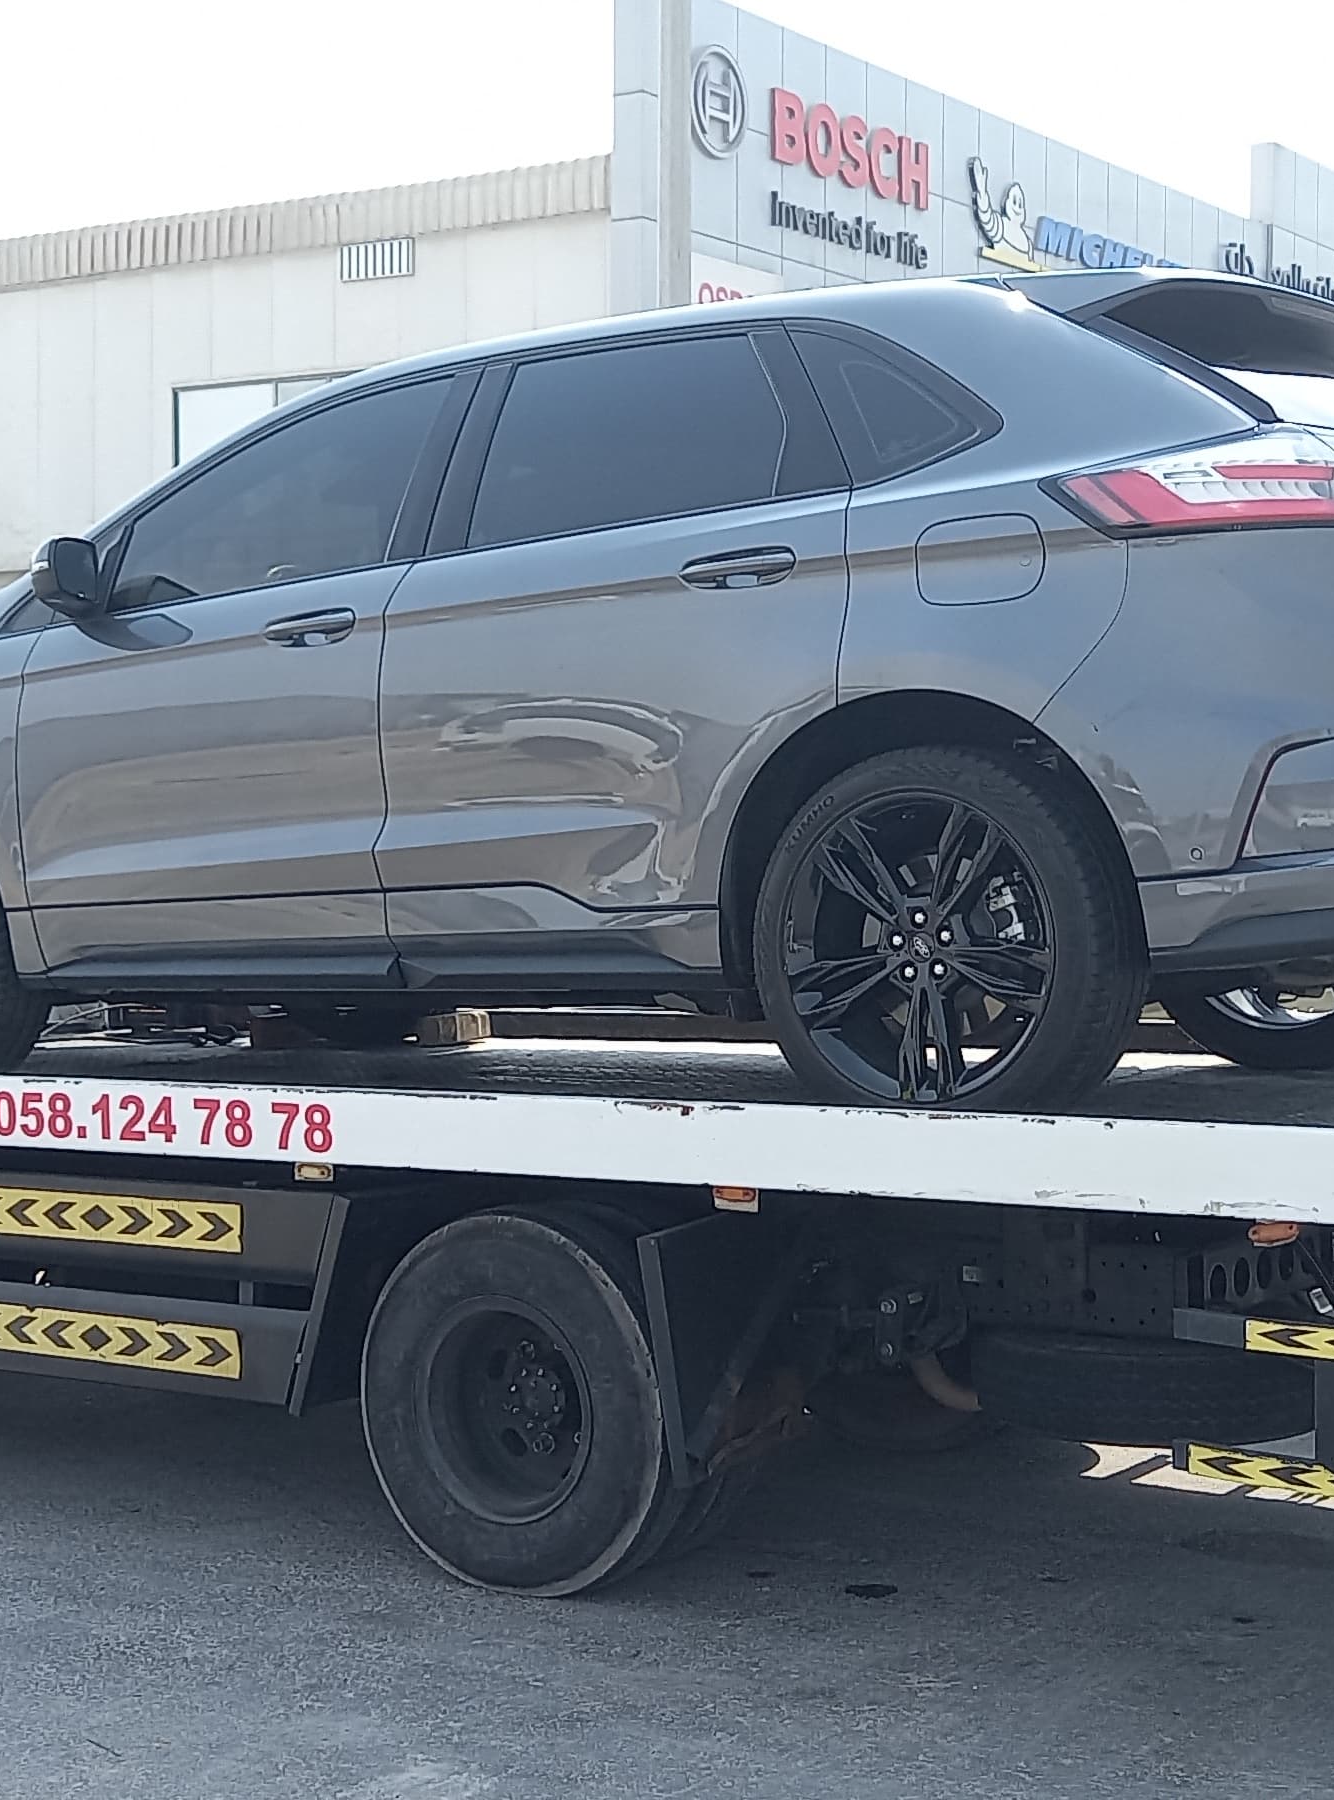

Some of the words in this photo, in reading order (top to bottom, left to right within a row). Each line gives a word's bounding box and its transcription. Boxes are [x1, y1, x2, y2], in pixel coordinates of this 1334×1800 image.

[769, 87, 929, 210] BOSCH
[770, 190, 862, 250] Invented
[865, 220, 895, 259] for
[897, 231, 928, 270] life
[1034, 215, 1183, 268] MICHE
[785, 794, 835, 854] KUMHO
[192, 1098, 254, 1148] 78
[270, 1101, 333, 1153] 78
